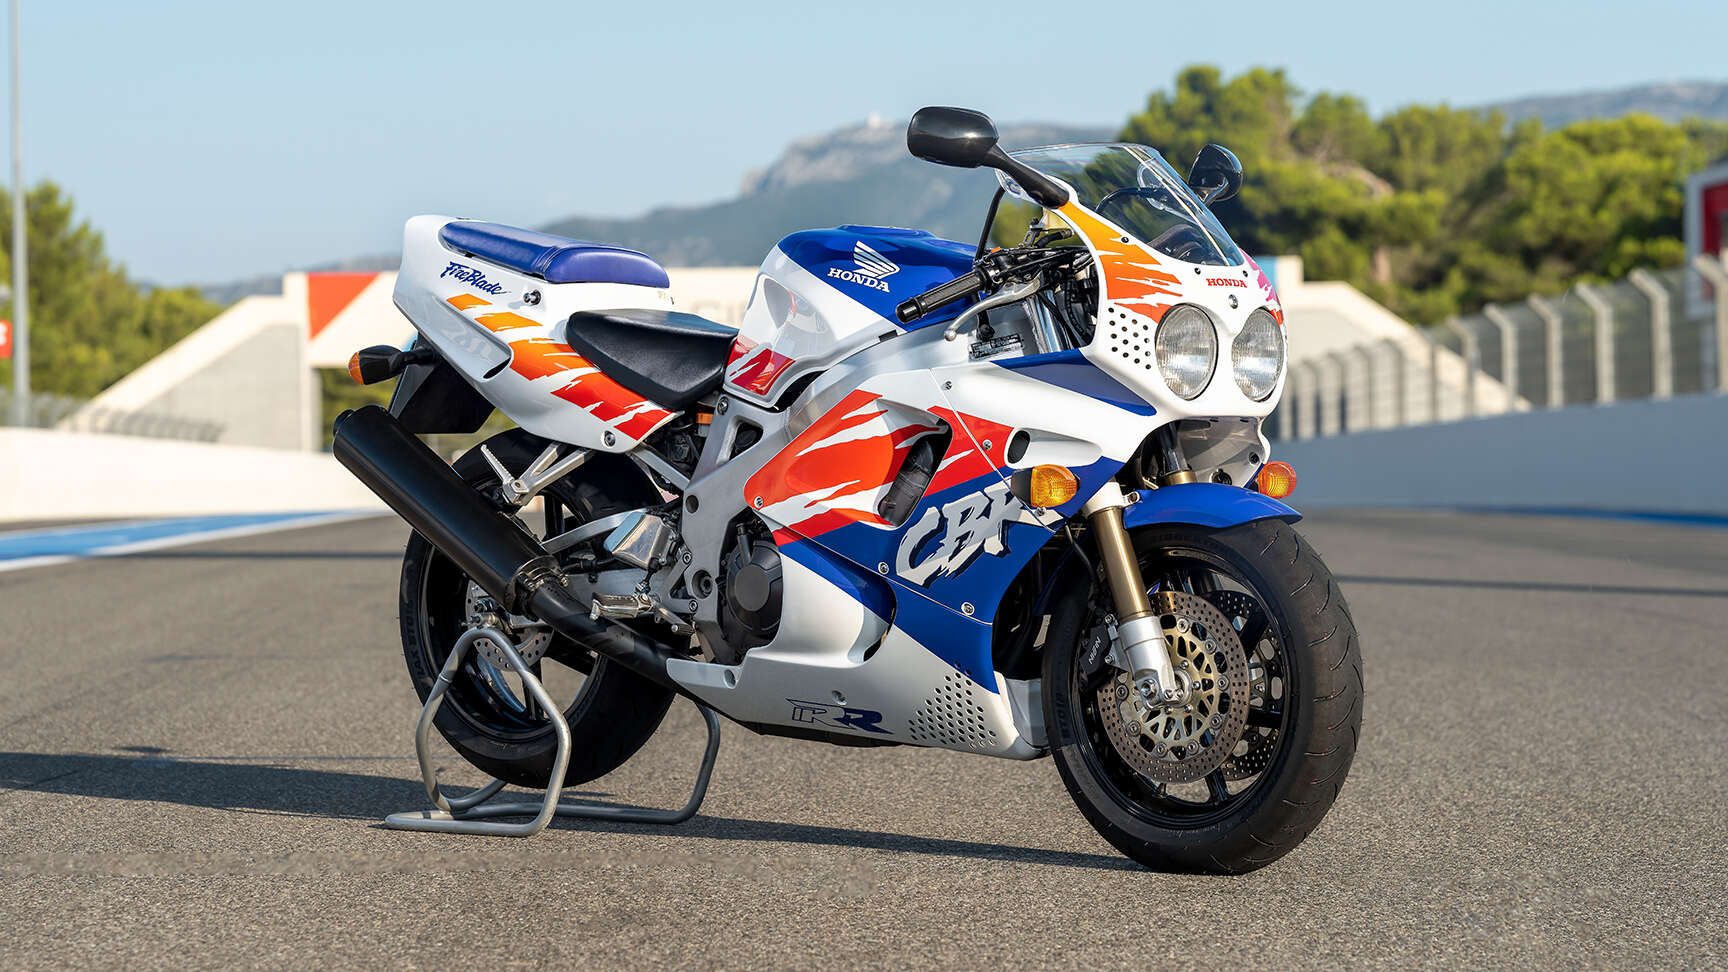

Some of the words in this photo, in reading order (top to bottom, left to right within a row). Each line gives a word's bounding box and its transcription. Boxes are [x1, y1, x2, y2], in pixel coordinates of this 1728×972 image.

[440, 261, 508, 295] FireBlade
[827, 267, 890, 293] HONDA
[1205, 278, 1248, 288] HONDA
[895, 475, 1063, 587] CBR
